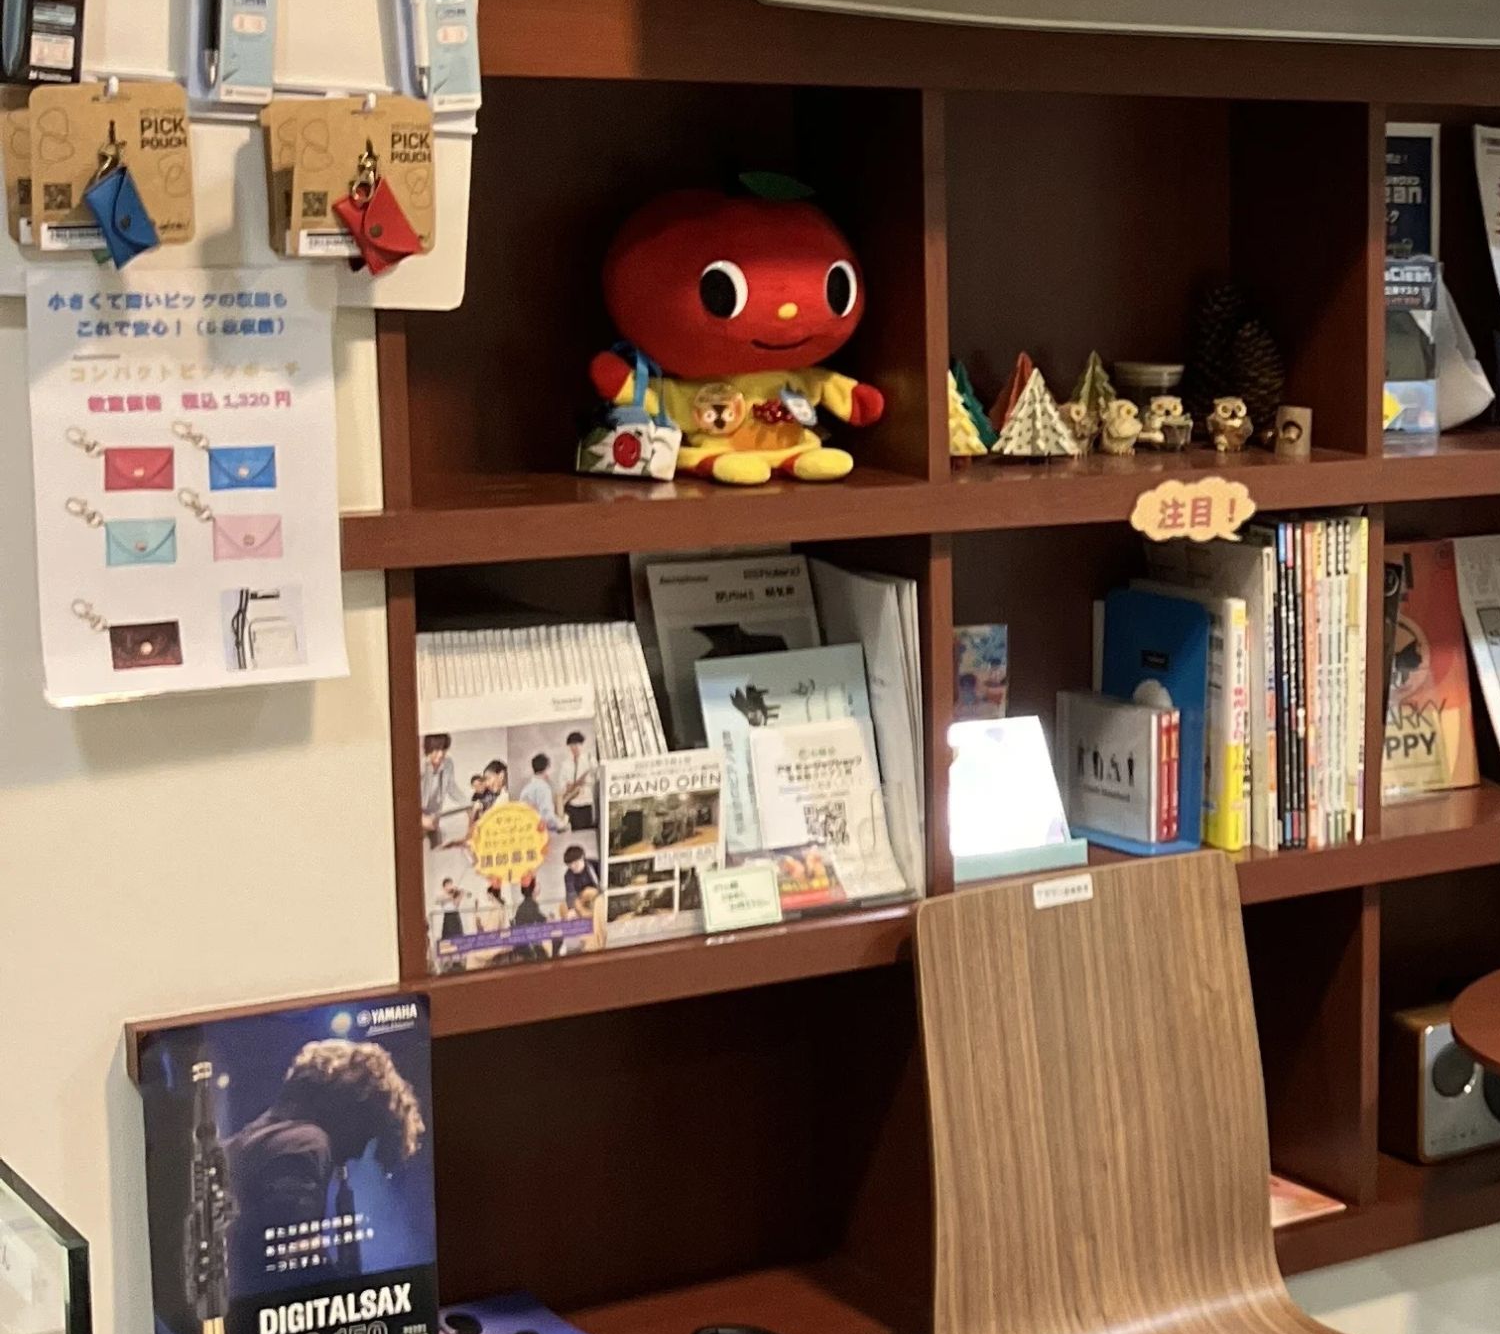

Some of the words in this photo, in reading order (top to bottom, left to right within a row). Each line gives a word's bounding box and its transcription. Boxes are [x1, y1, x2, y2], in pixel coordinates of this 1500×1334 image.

[140, 117, 186, 136] PICK
[140, 136, 188, 150] POUCH
[391, 133, 431, 151] PICK
[391, 151, 432, 164] POUCH
[1157, 496, 1240, 531] 注目！
[608, 775, 671, 796] GRAND
[676, 771, 721, 789] OPEN
[370, 1003, 418, 1025] YAMAHA
